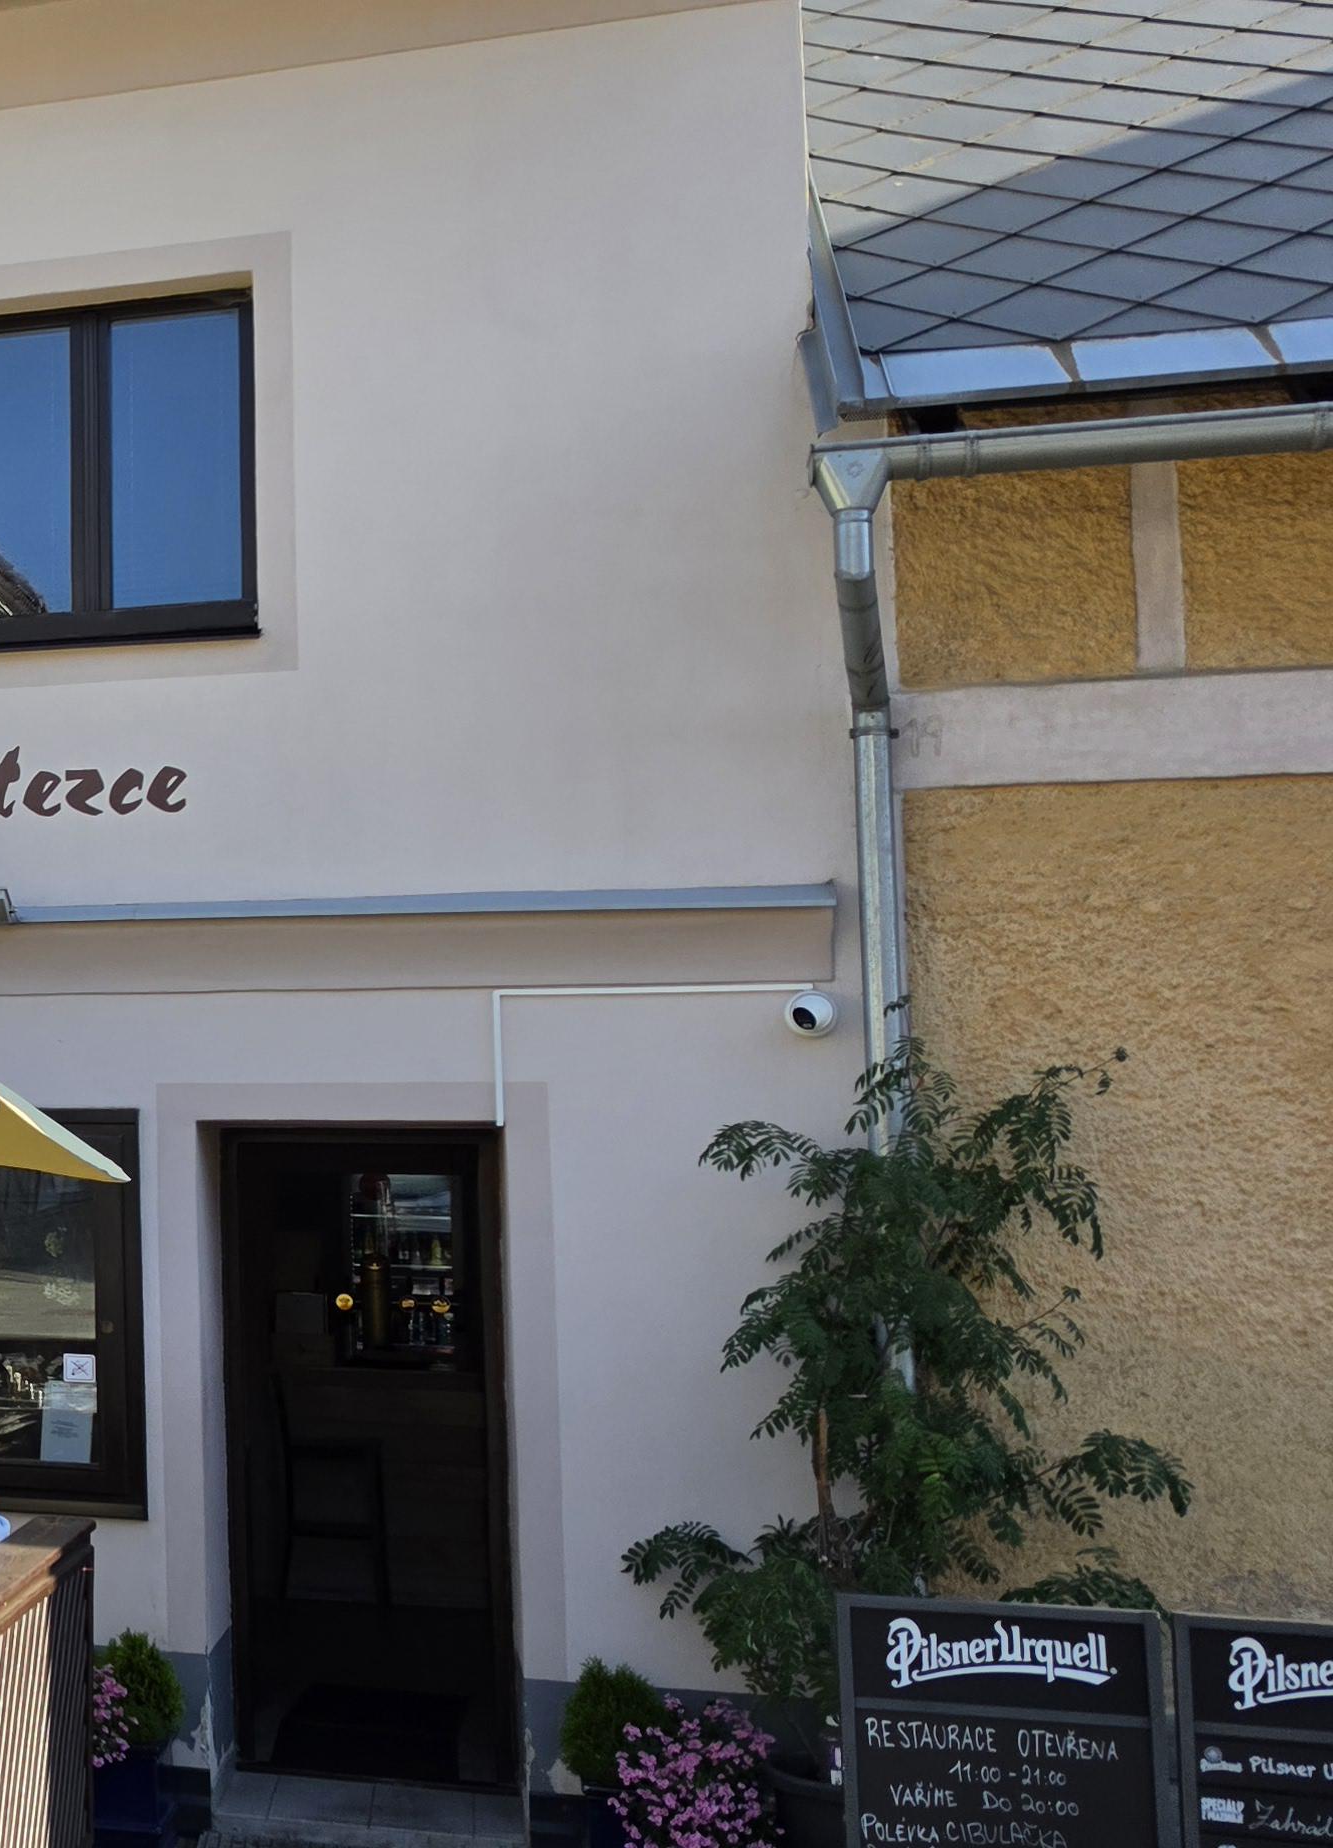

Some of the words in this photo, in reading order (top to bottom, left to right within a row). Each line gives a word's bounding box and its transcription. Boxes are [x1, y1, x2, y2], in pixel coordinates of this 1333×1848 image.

[886, 1617, 1000, 1688] Pilsner
[994, 1620, 1109, 1683] Urquell
[865, 1717, 997, 1752] RESTAURACE
[1017, 1729, 1119, 1762] OTEVŘENA
[949, 1760, 1000, 1784] 11:00
[1021, 1765, 1067, 1786] 21:00
[1249, 1755, 1316, 1778] Pilsner
[1021, 1793, 1079, 1816] 20:00
[861, 1814, 940, 1844] POLÉVKA
[946, 1822, 1068, 1848] CIBULAČKA
